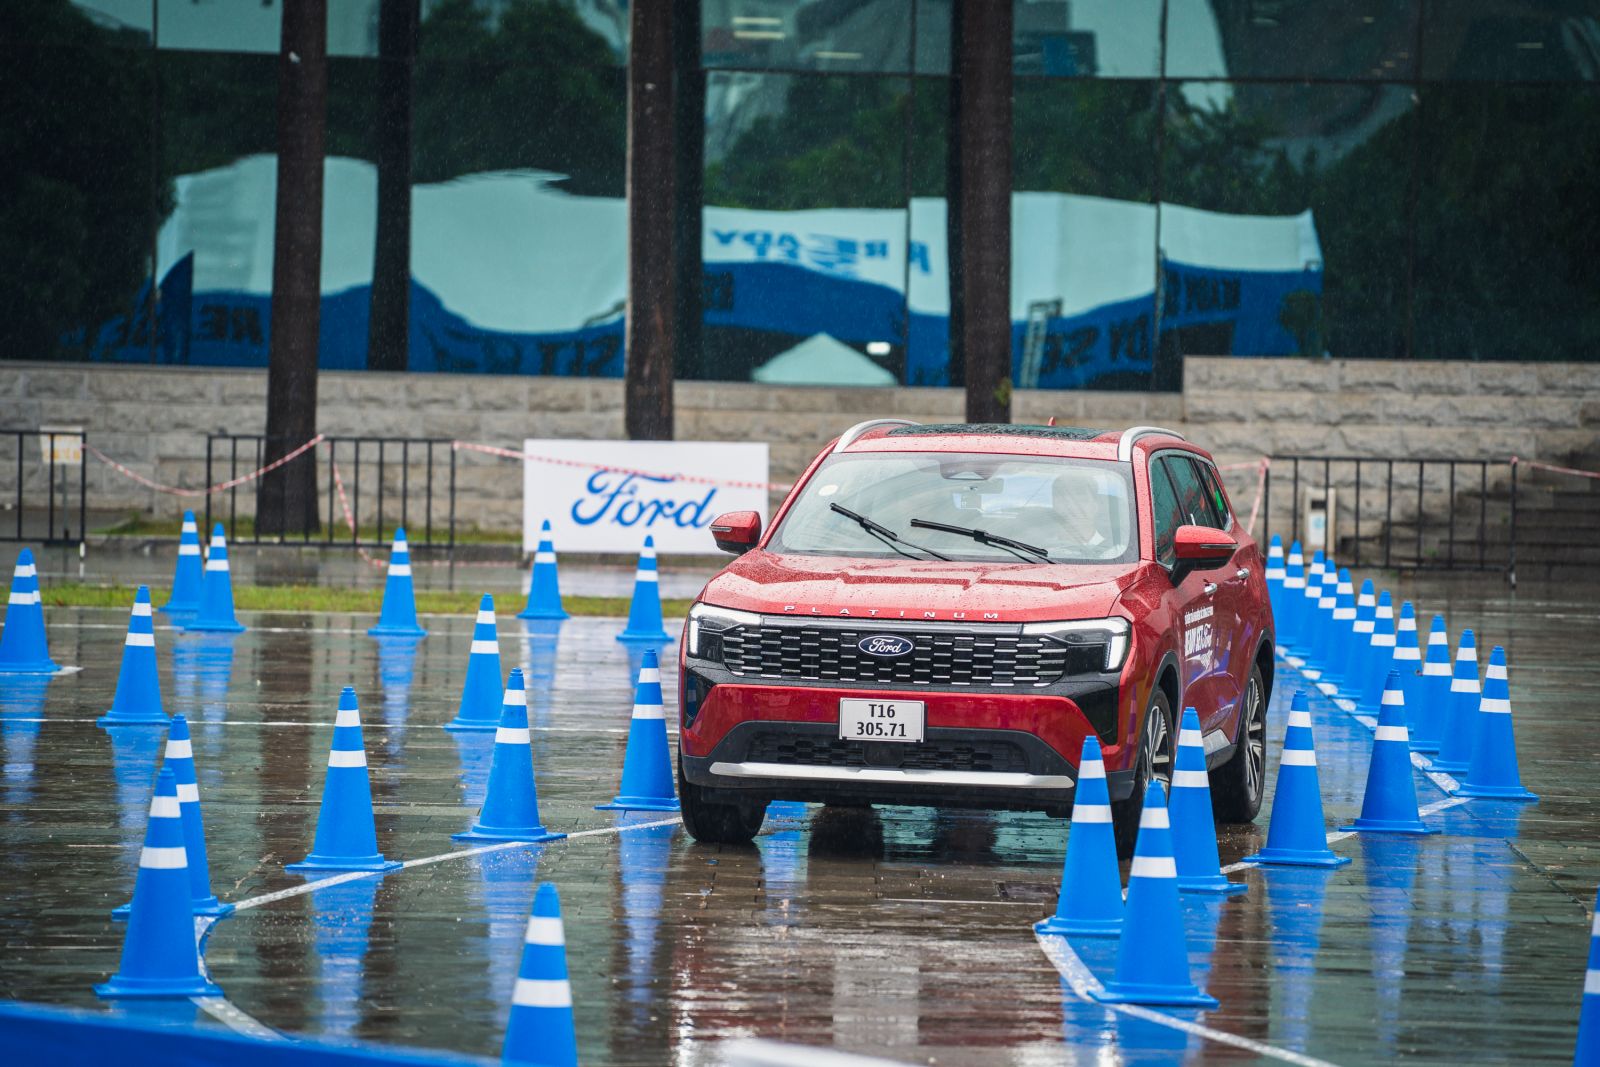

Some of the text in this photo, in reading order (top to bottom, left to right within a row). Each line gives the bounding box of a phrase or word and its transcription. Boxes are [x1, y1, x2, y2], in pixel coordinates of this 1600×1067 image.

[571, 469, 717, 529] Ford
[784, 605, 999, 619] PLATINUM
[868, 637, 903, 653] Ford
[868, 703, 896, 718] T16
[856, 721, 907, 737] 305.71
